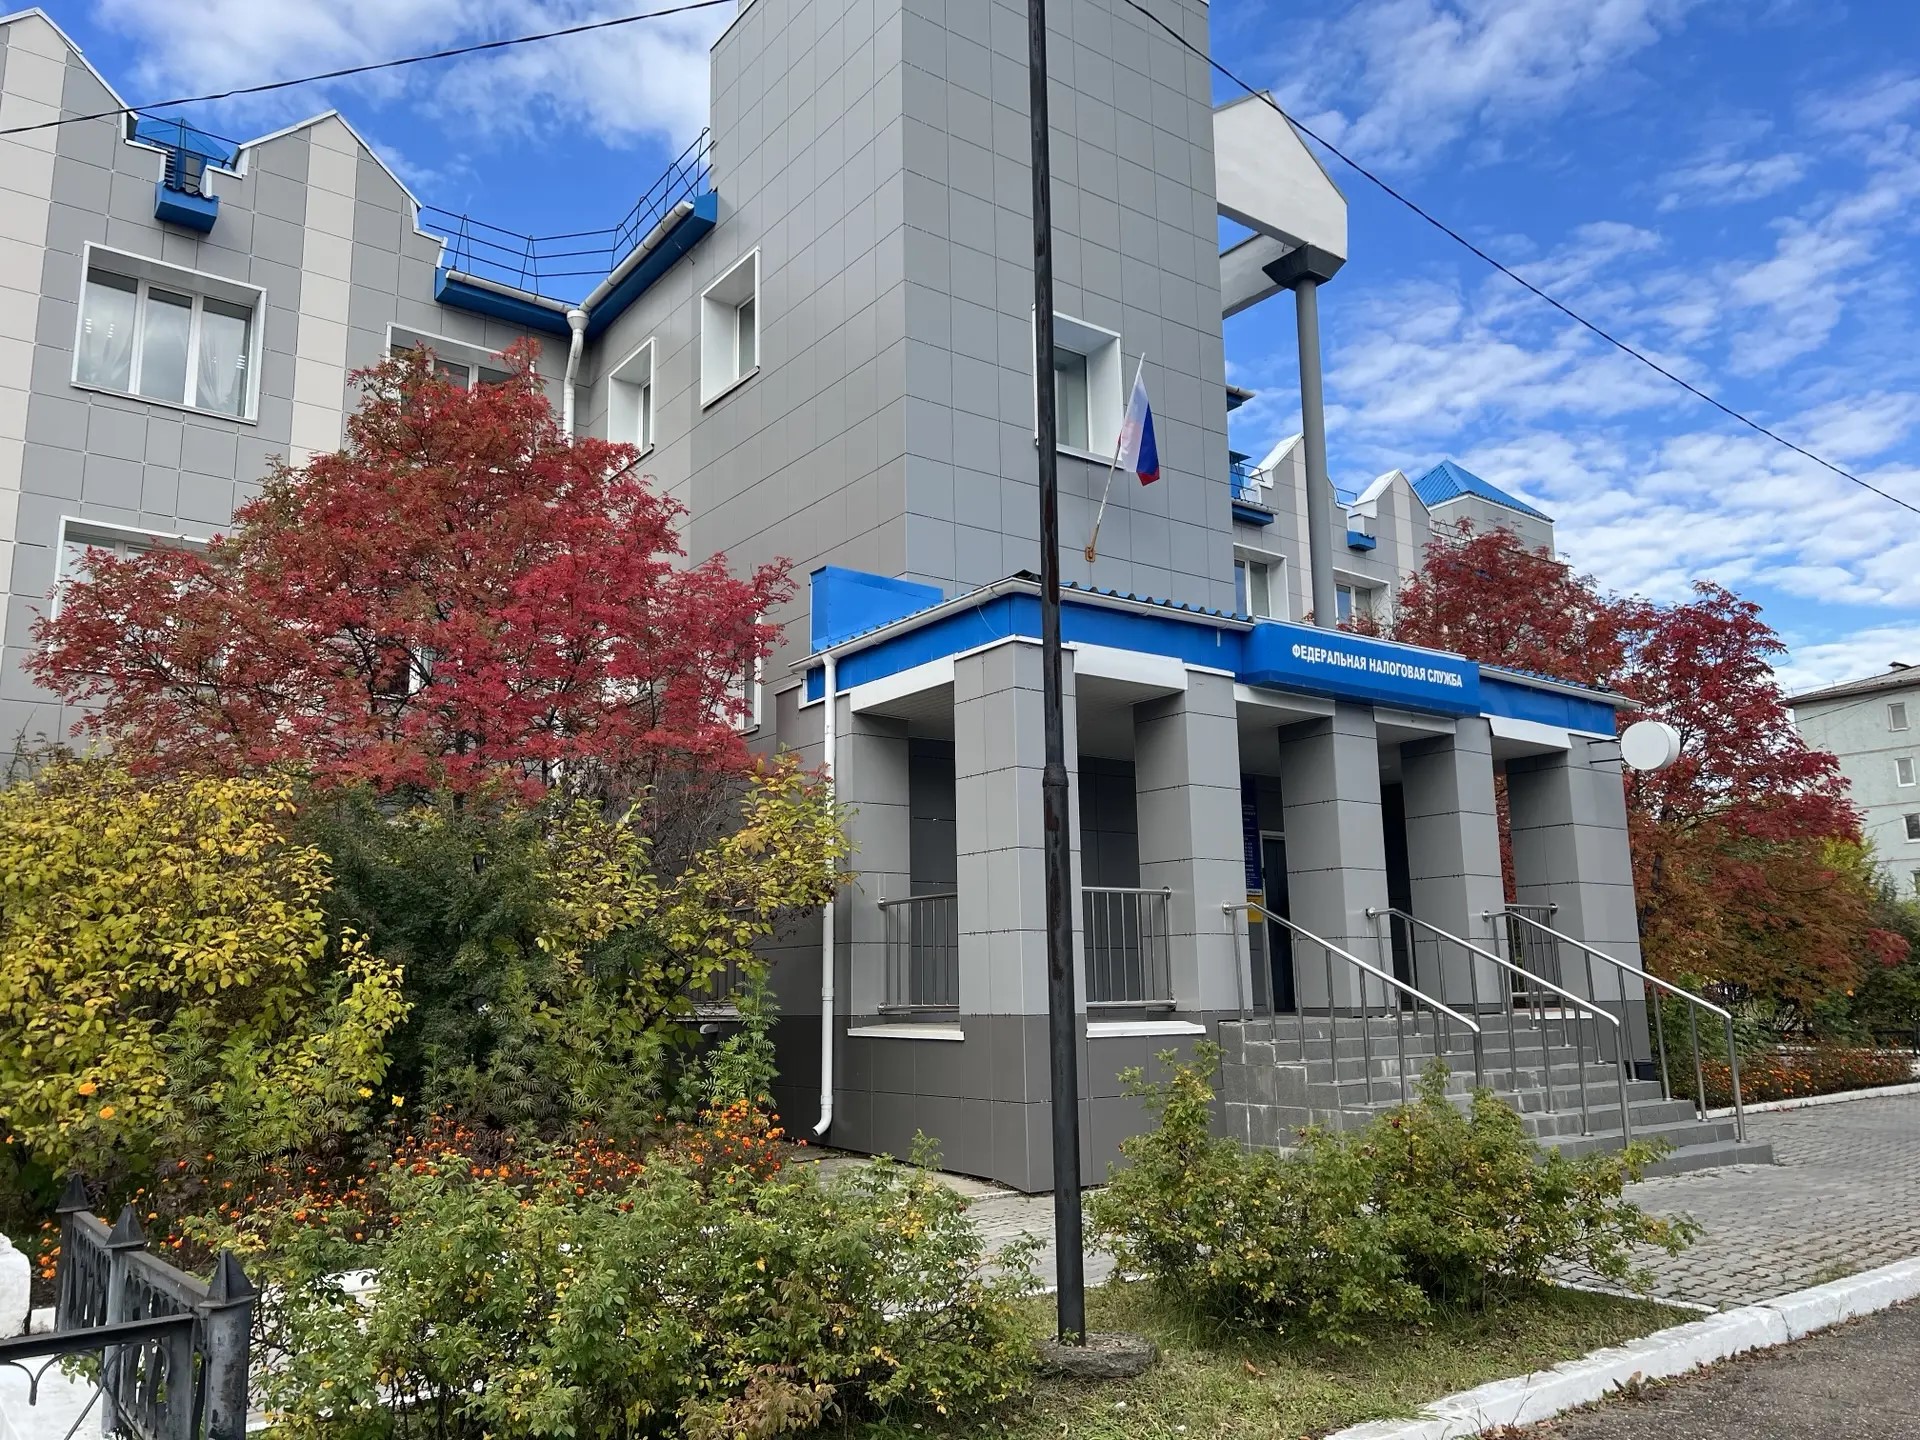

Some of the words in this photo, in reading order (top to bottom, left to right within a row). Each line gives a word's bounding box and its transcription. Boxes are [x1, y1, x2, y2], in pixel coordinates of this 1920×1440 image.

[1292, 644, 1367, 670] ФЕДЕРАЛЬНАЯ
[1369, 659, 1426, 681] НАЛОГОВАЯ
[1427, 669, 1463, 688] СЛУЖБА
